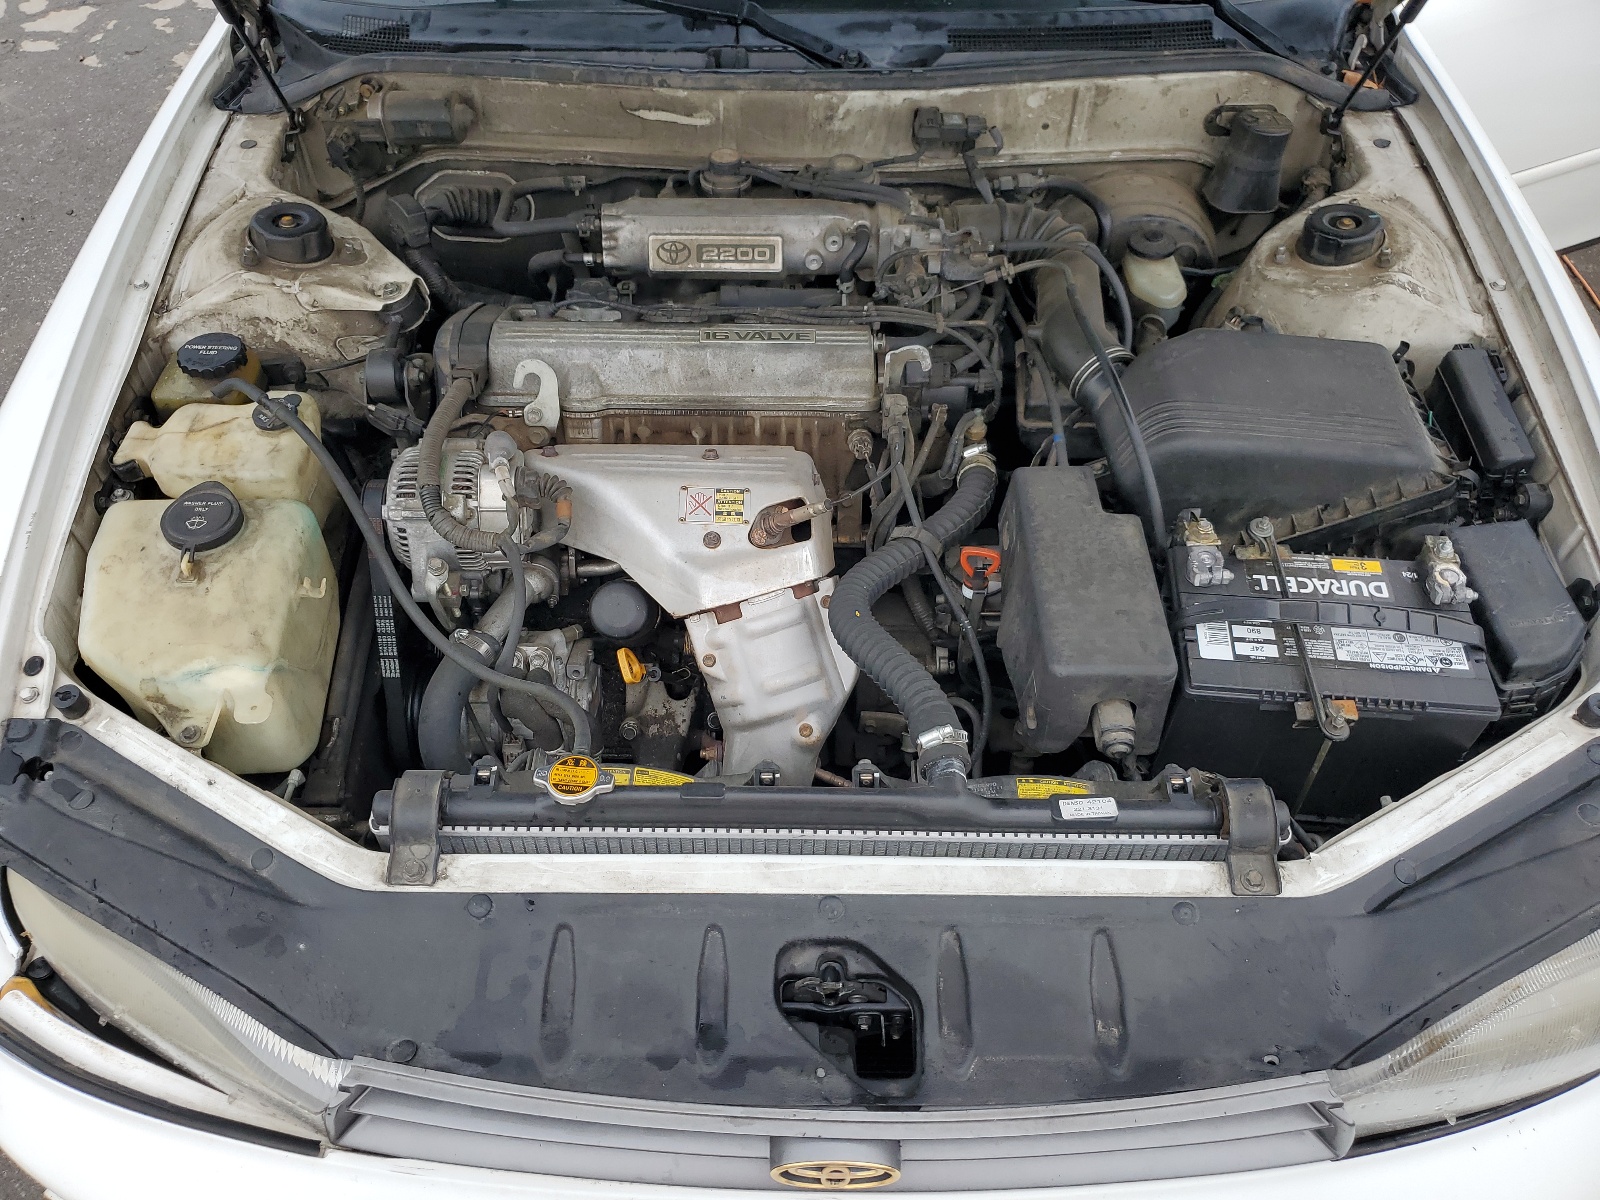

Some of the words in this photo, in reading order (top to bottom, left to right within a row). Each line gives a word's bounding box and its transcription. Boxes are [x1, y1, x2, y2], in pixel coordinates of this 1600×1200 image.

[702, 247, 770, 260] 2200
[704, 331, 730, 340] 16
[734, 331, 812, 341] VALVE
[1360, 562, 1368, 571] 3
[1246, 627, 1262, 635] 890
[1249, 645, 1266, 653] 24F
[557, 784, 583, 792] CAUTION
